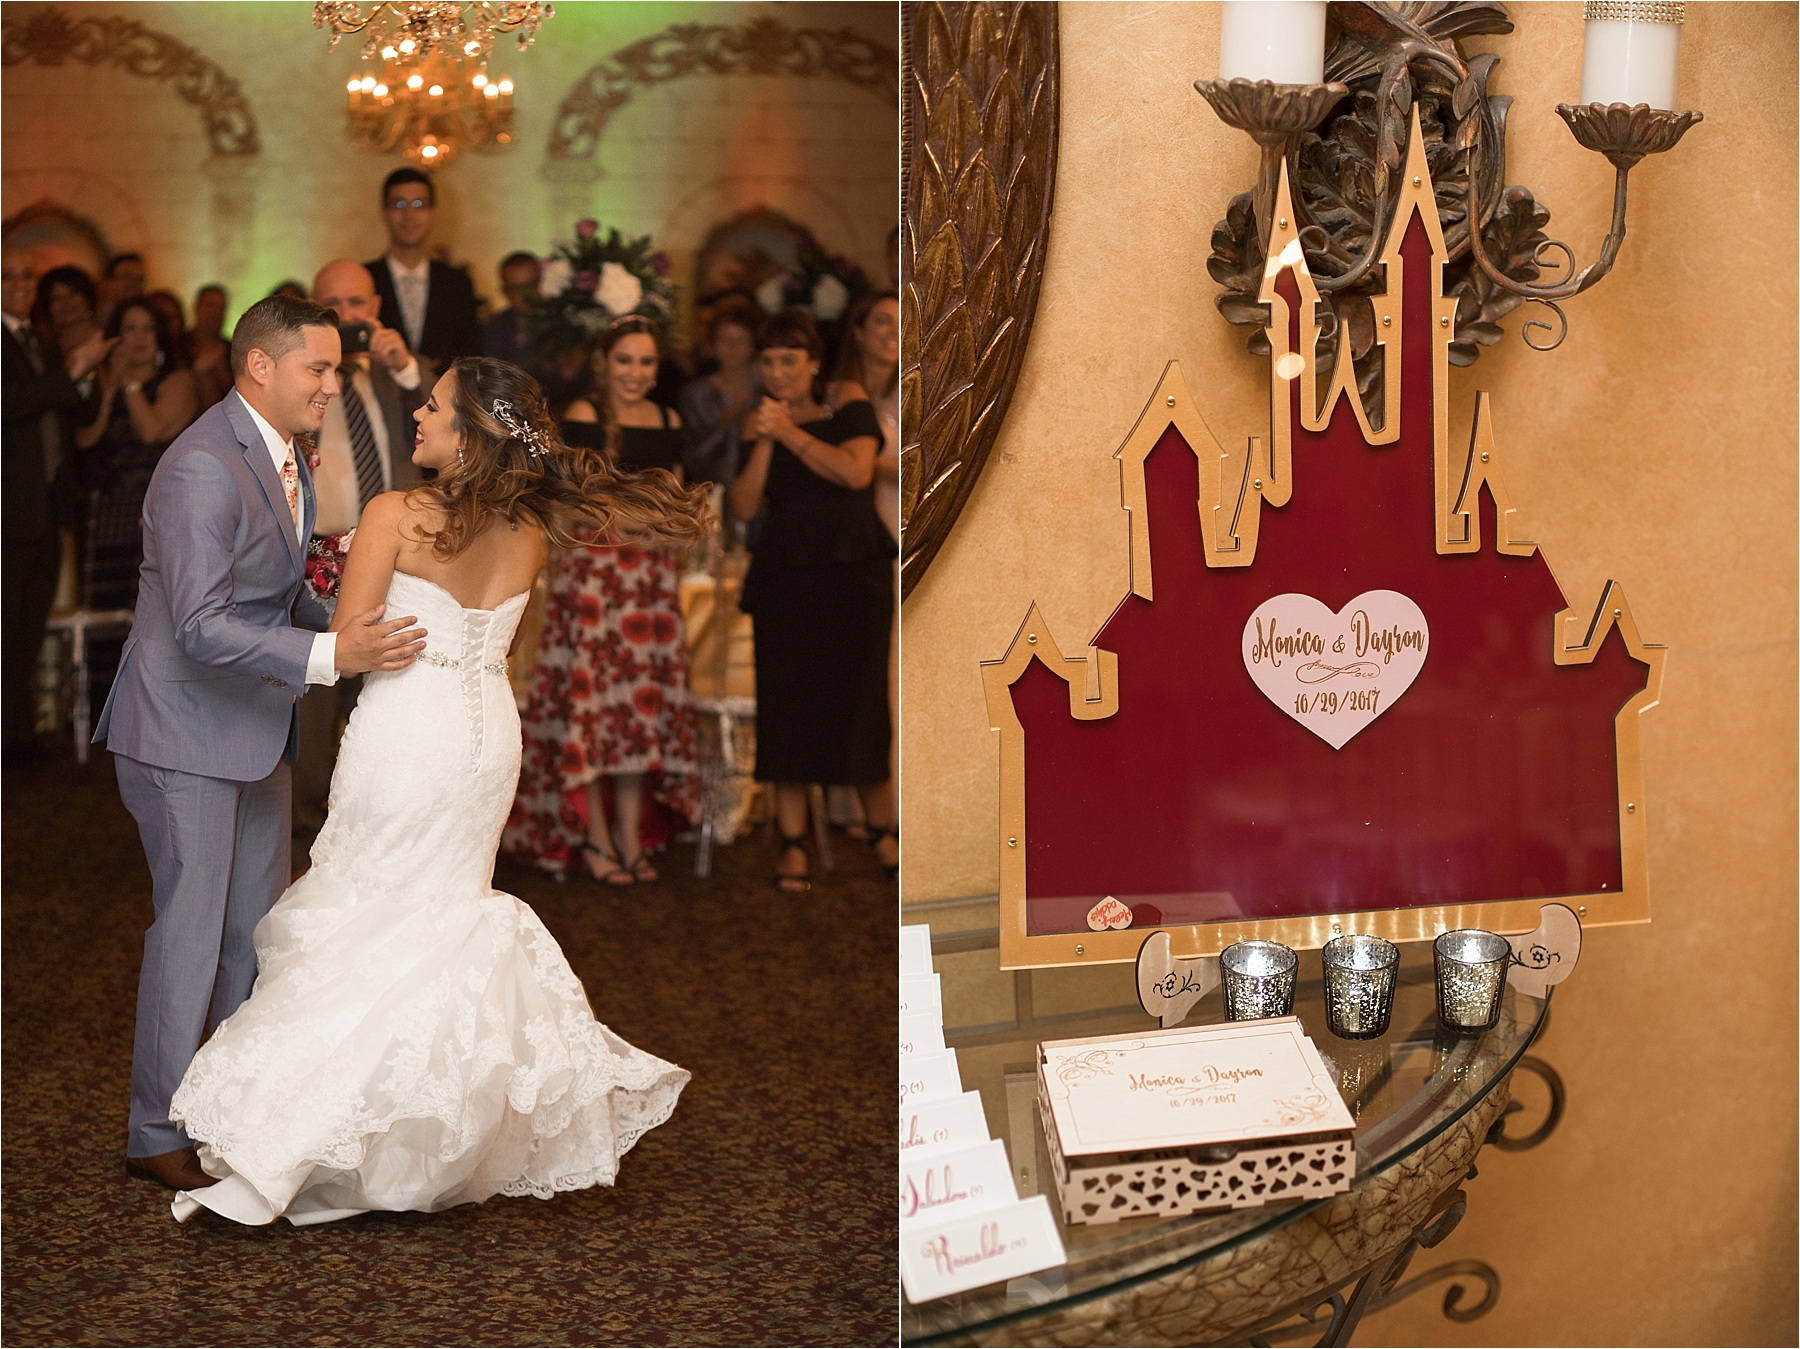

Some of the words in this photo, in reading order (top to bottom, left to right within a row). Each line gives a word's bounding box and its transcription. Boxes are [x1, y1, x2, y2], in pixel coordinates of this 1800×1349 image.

[1252, 616, 1325, 668] Monica
[1332, 634, 1346, 654] &
[1350, 610, 1425, 665] Dayron
[1294, 686, 1381, 715] 10/29/2017
[1129, 1073, 1185, 1092] Monica
[1202, 1064, 1263, 1084] Dayron
[1169, 1093, 1236, 1108] 10/29/2017
